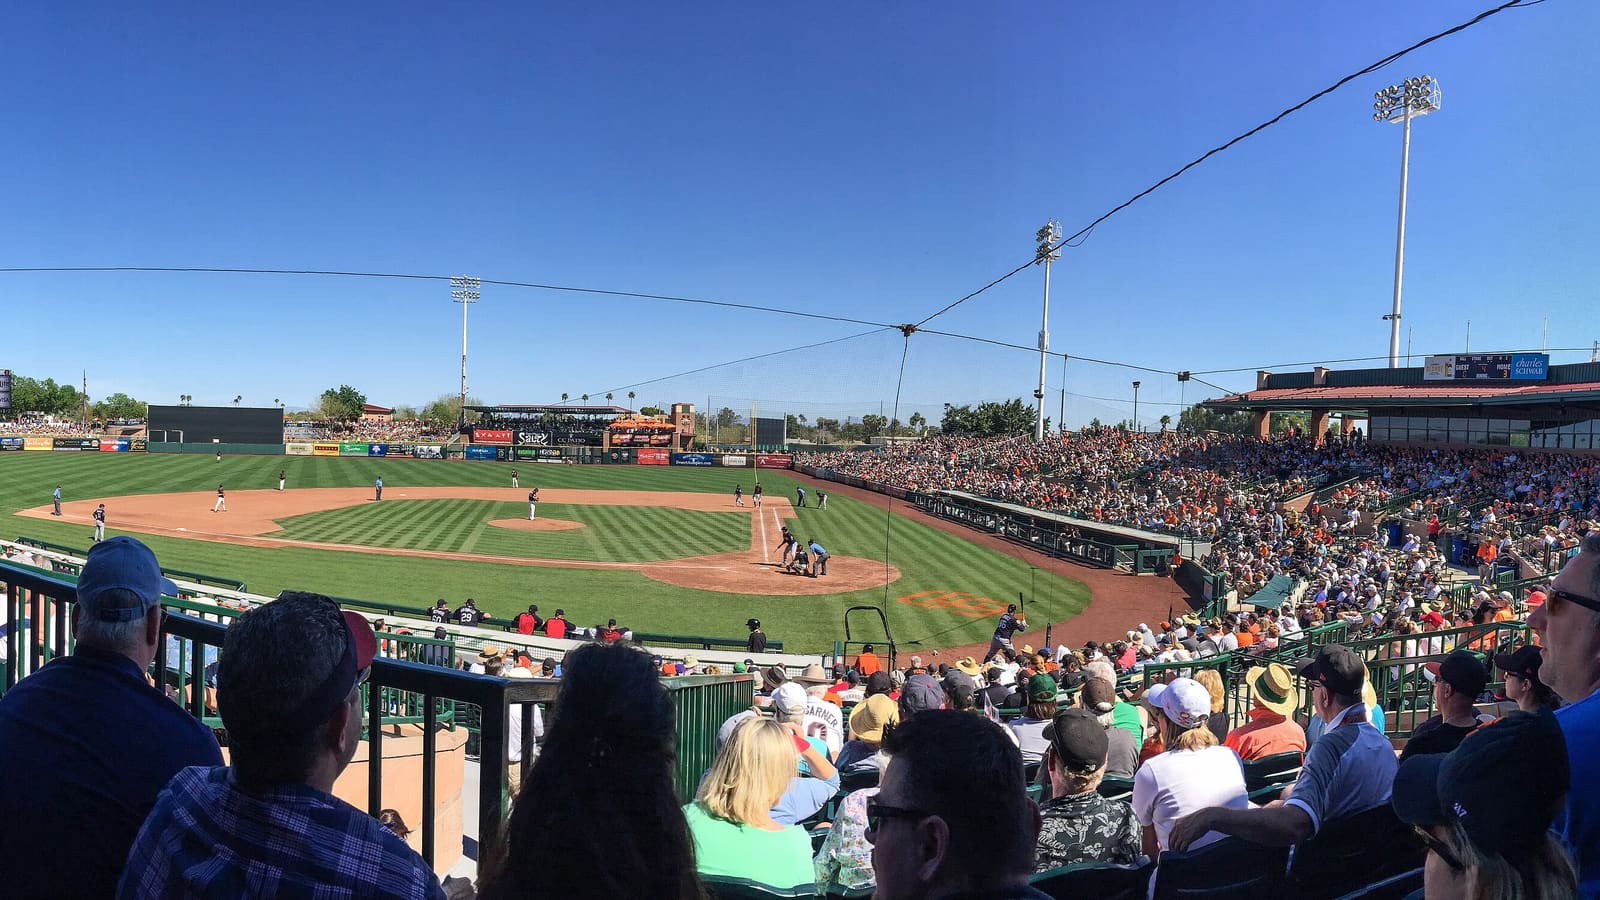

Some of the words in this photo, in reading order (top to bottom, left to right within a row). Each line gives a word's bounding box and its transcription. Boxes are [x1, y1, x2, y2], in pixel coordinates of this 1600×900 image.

[1516, 358, 1543, 368] charles
[1515, 367, 1543, 375] SCHWAB
[461, 613, 472, 622] 29
